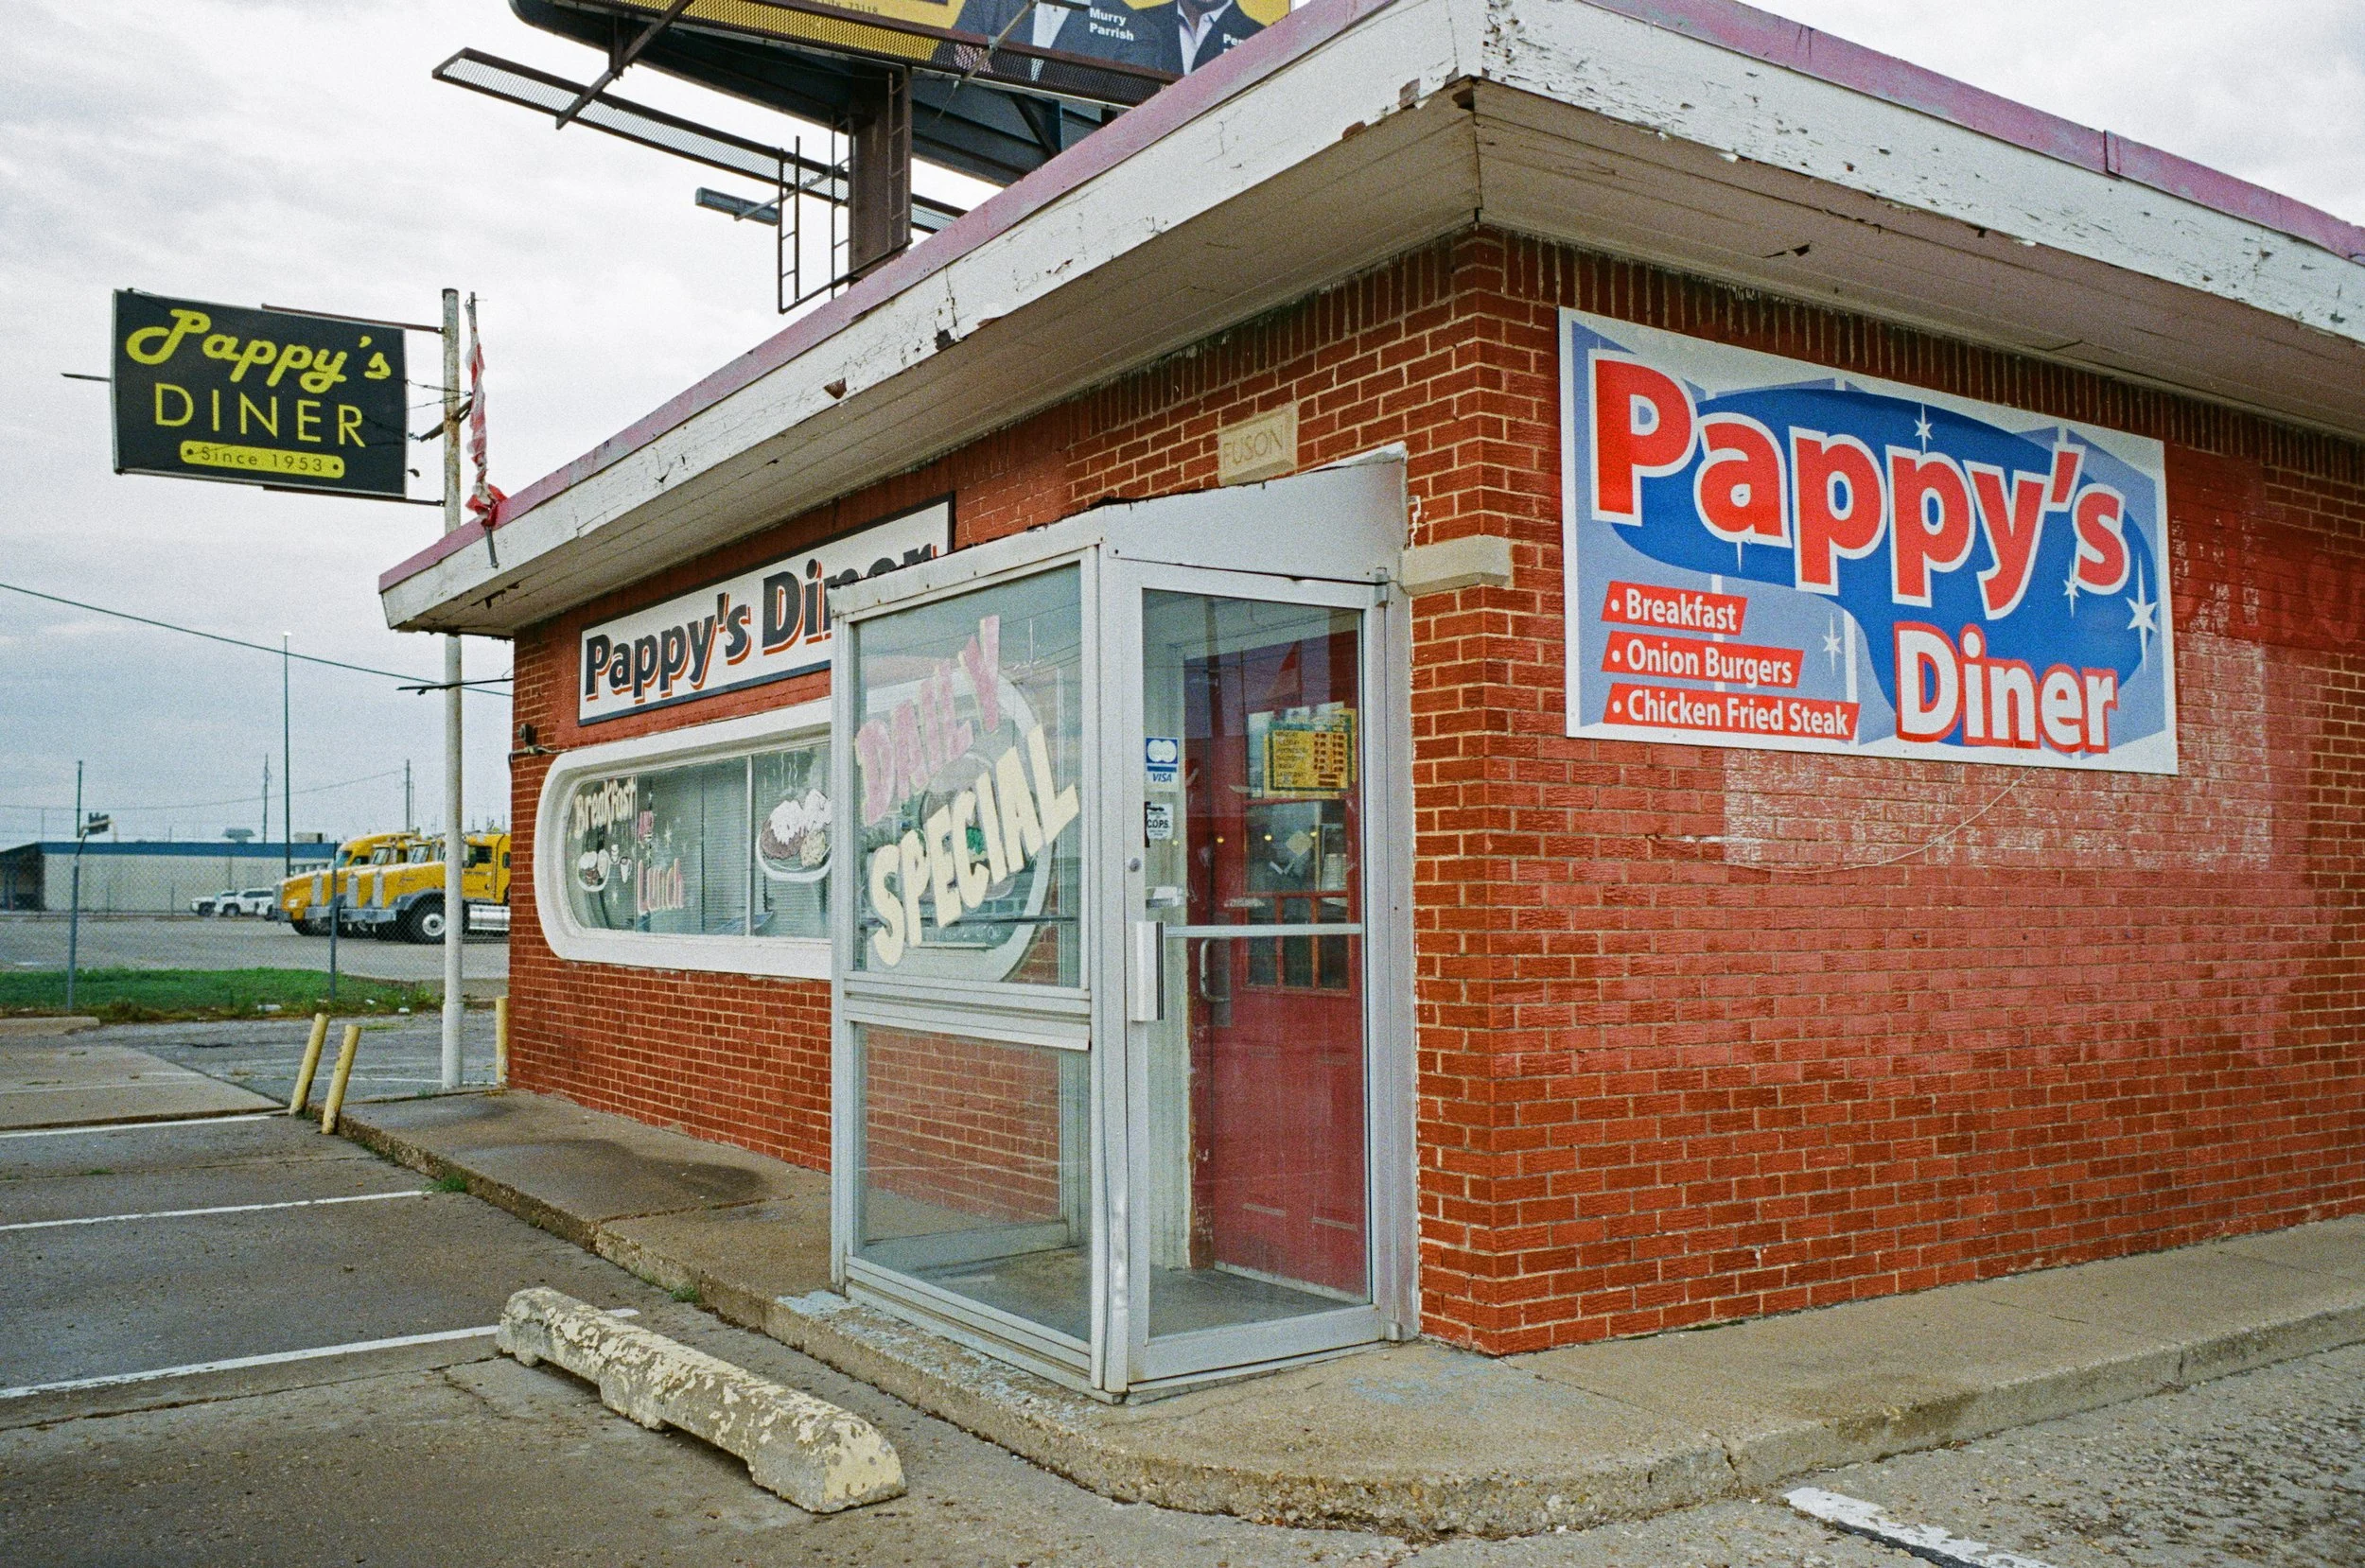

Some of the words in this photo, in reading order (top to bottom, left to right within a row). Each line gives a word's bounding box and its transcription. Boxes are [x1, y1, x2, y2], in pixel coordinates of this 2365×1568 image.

[1089, 8, 1127, 26] Murry
[1089, 23, 1134, 41] Parrish
[126, 308, 392, 393] Pappy's
[154, 383, 365, 447] DINER
[200, 446, 258, 465] Since
[272, 455, 323, 472] 1953
[1222, 425, 1284, 469] FUSON
[1588, 348, 2130, 620] Pappy's
[586, 592, 751, 704] Pappy's
[762, 543, 937, 654] Din
[1625, 587, 1737, 631] Breakfast
[1626, 638, 1699, 676] Onion
[1704, 646, 1793, 688] Burgers
[1893, 620, 2119, 754] Diner
[854, 615, 1000, 827] DAILY
[1627, 689, 1721, 726] Chicken
[1726, 697, 1783, 732] Fried
[1789, 702, 1849, 736] Steak
[1152, 772, 1172, 783] VISA
[573, 775, 636, 840] Breakfast
[868, 723, 1079, 967] SPECIAL
[637, 857, 684, 916] Lunch
